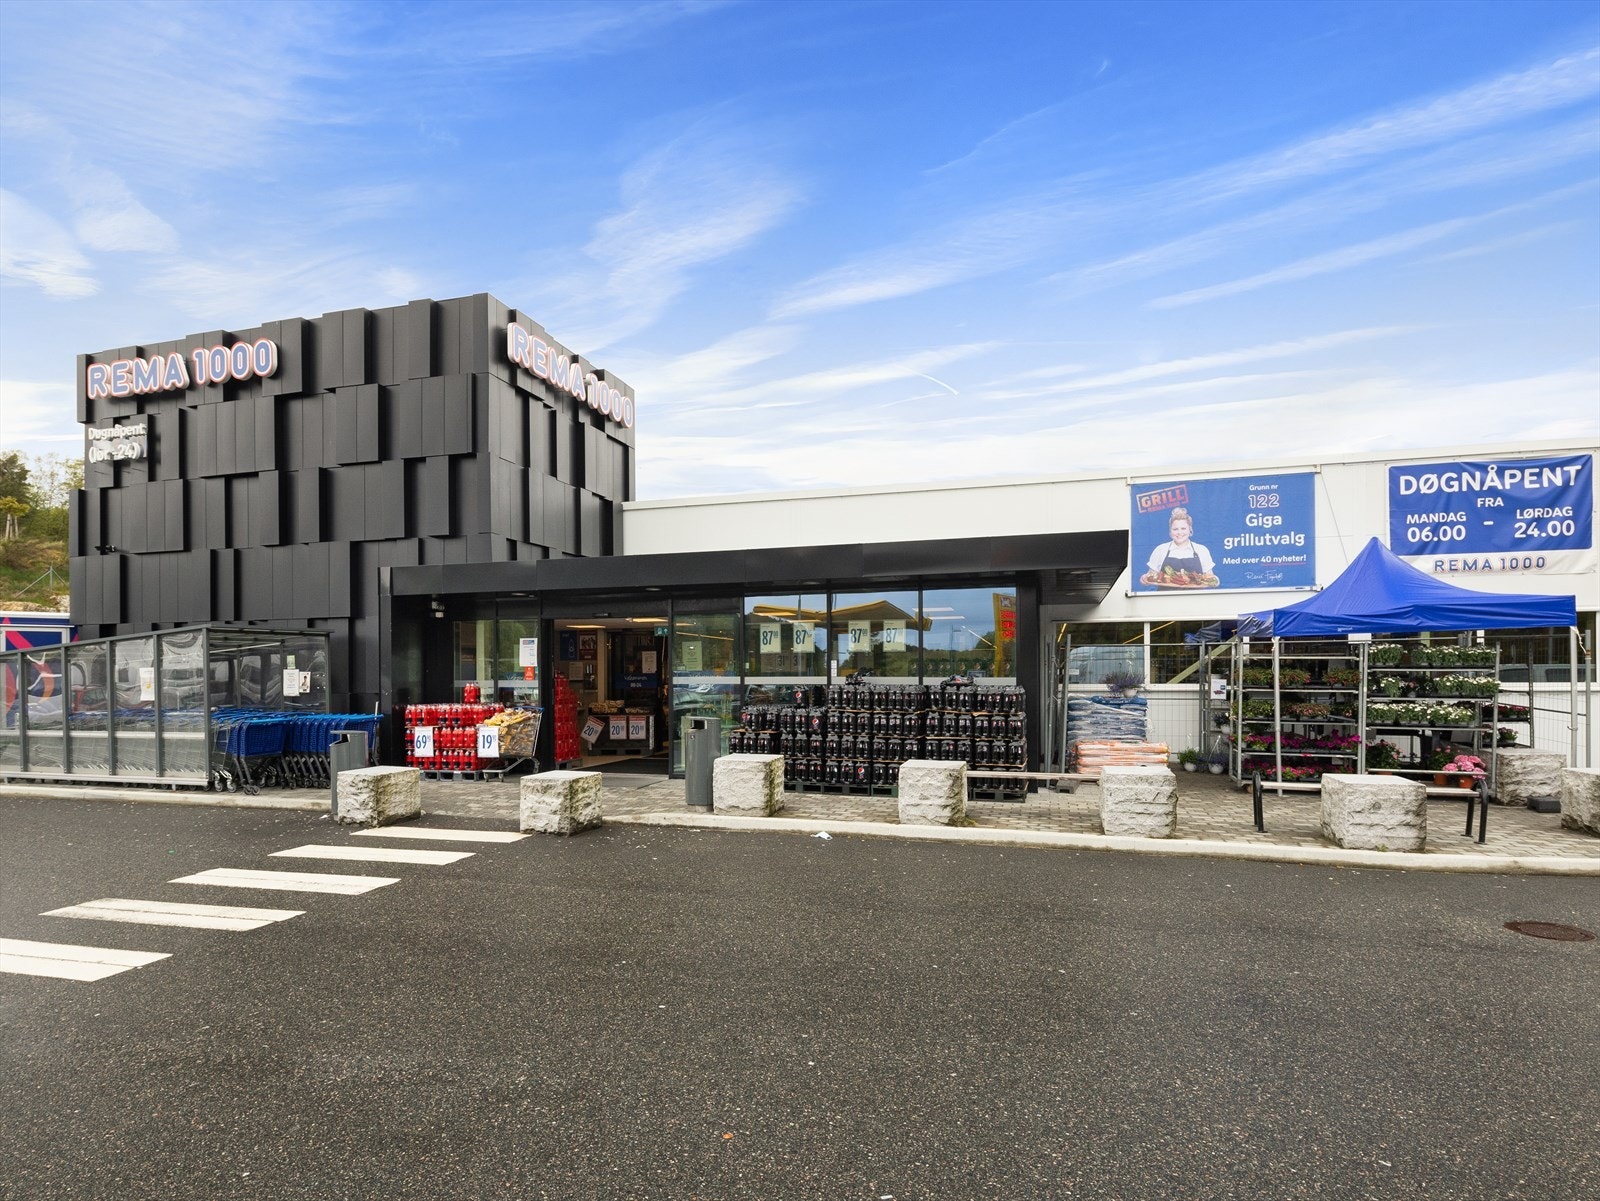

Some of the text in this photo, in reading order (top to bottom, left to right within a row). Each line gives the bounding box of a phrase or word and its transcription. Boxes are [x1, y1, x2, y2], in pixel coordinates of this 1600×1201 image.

[87, 338, 278, 399] REMA 1000
[507, 322, 633, 428] REMA 1000
[1400, 464, 1582, 495] DØGNÅPENT
[1141, 489, 1185, 508] GRILL
[1248, 493, 1280, 509] 122
[1477, 497, 1504, 508] FRA
[1245, 513, 1282, 528] Giga
[1406, 506, 1573, 525] MANDAG LØRDAG
[1223, 531, 1305, 550] grillutvalg
[1407, 524, 1466, 543] 06.00
[1514, 519, 1575, 538] 24.00
[1222, 556, 1240, 565] Med
[1260, 555, 1272, 563] 40
[1272, 554, 1307, 563] nyheter!
[1434, 556, 1546, 573] REMA 1000
